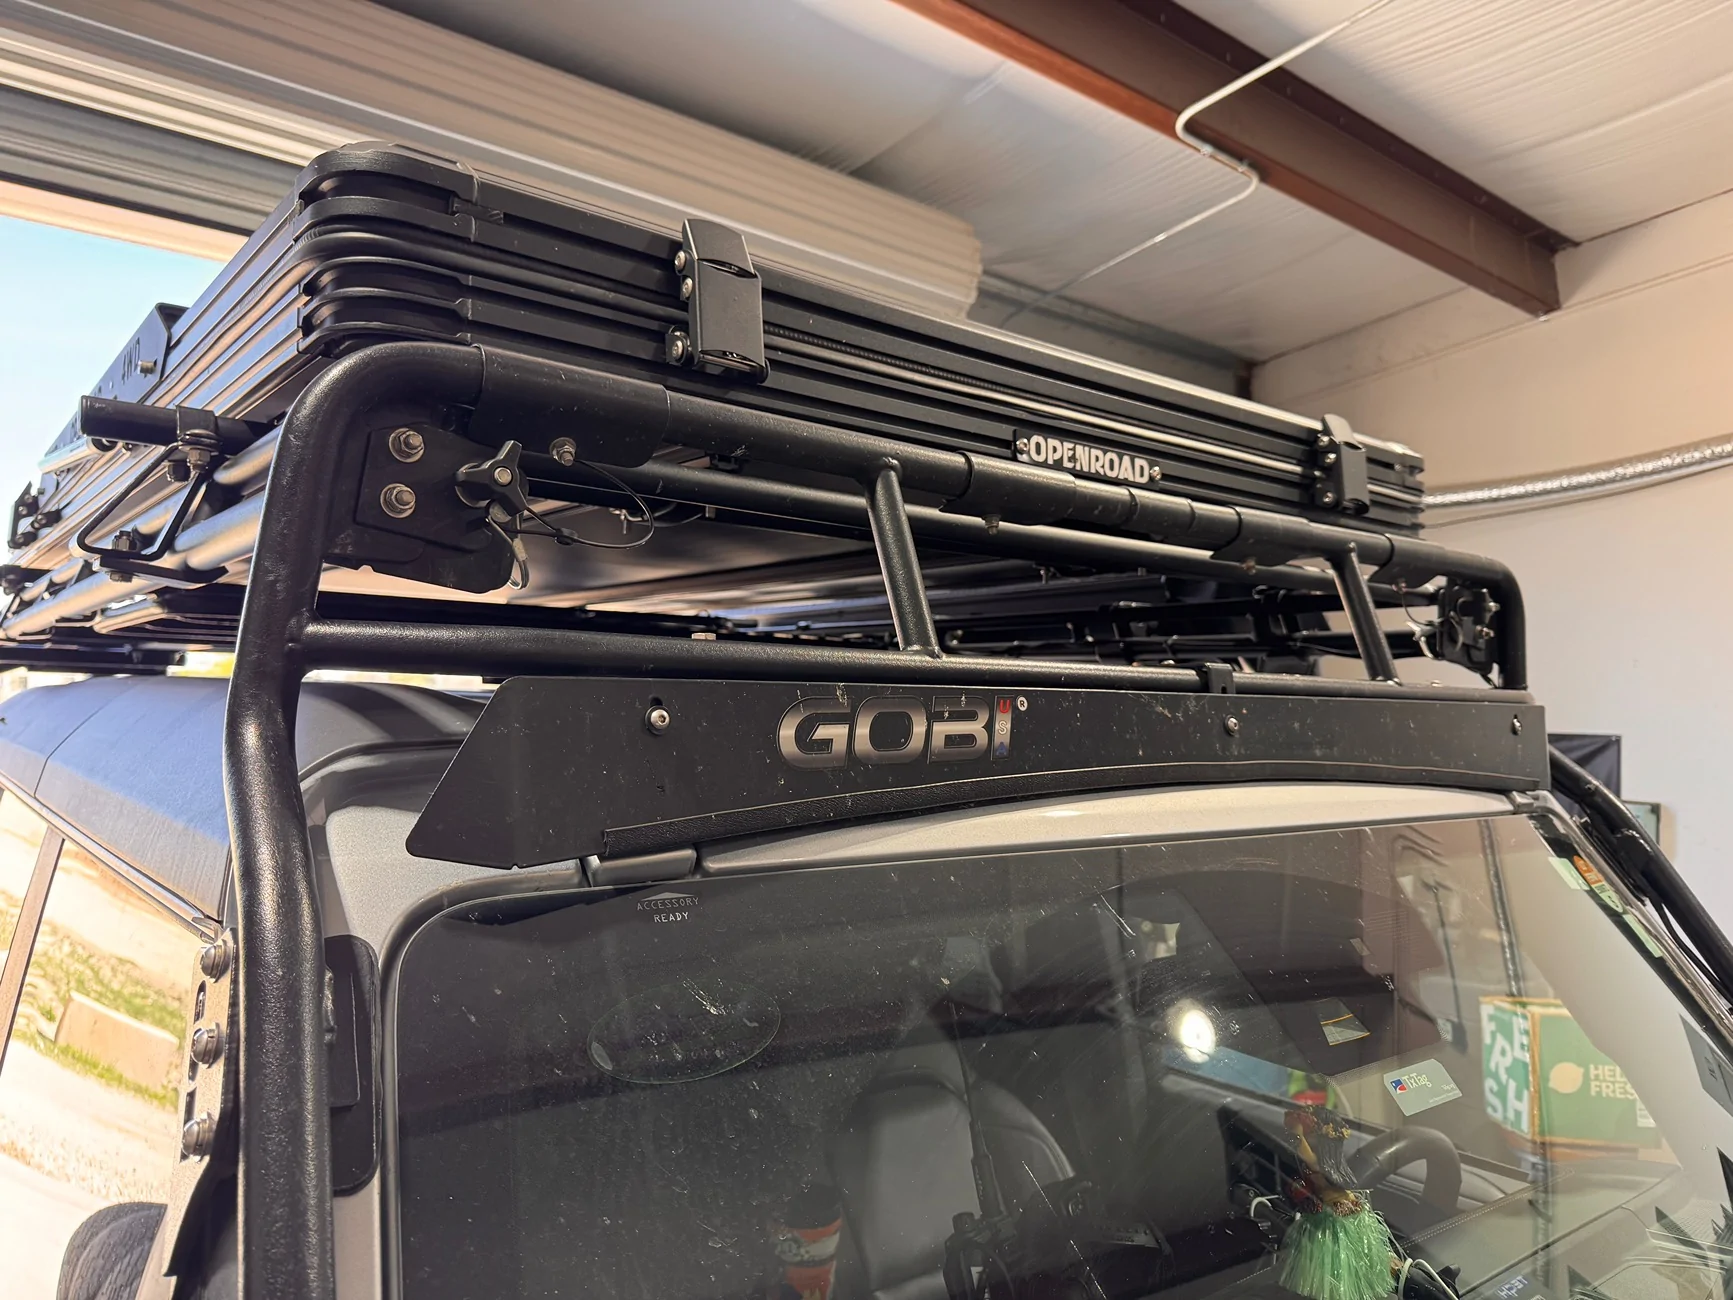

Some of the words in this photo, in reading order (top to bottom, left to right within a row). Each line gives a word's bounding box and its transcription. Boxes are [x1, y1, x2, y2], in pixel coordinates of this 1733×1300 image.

[1029, 434, 1150, 484] OPENROAD
[776, 695, 1013, 771] GOBI
[637, 897, 699, 911] ACCESSORY
[653, 911, 689, 923] READY
[1401, 1072, 1432, 1088] TxTag
[1590, 1064, 1628, 1082] HEL
[1590, 1081, 1639, 1100] FRES
